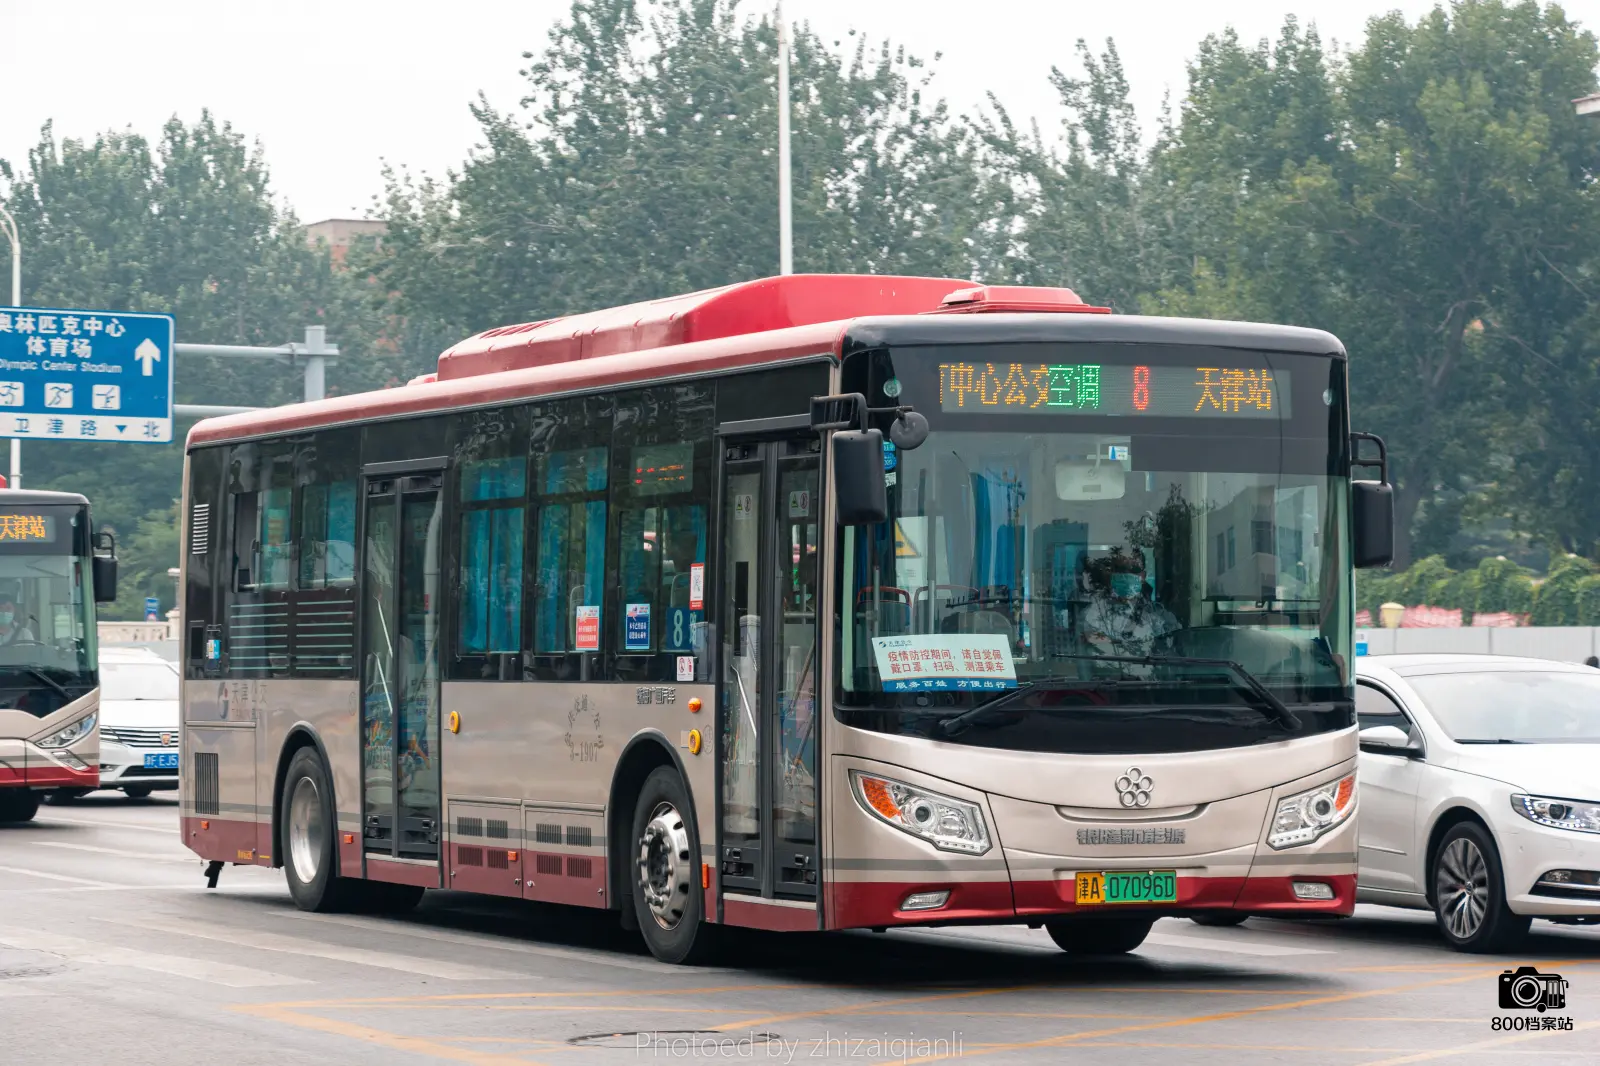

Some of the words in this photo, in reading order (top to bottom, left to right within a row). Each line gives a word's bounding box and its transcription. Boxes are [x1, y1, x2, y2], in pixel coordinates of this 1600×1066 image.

[0, 313, 126, 337] 奥林匹克中心
[26, 336, 92, 358] 体育场
[41, 360, 77, 371] Center
[81, 361, 122, 373] Stadium
[1047, 365, 1100, 409] 空调
[1133, 366, 1149, 410] 8
[1194, 367, 1273, 412] 天津站
[0, 515, 45, 540] 天津站
